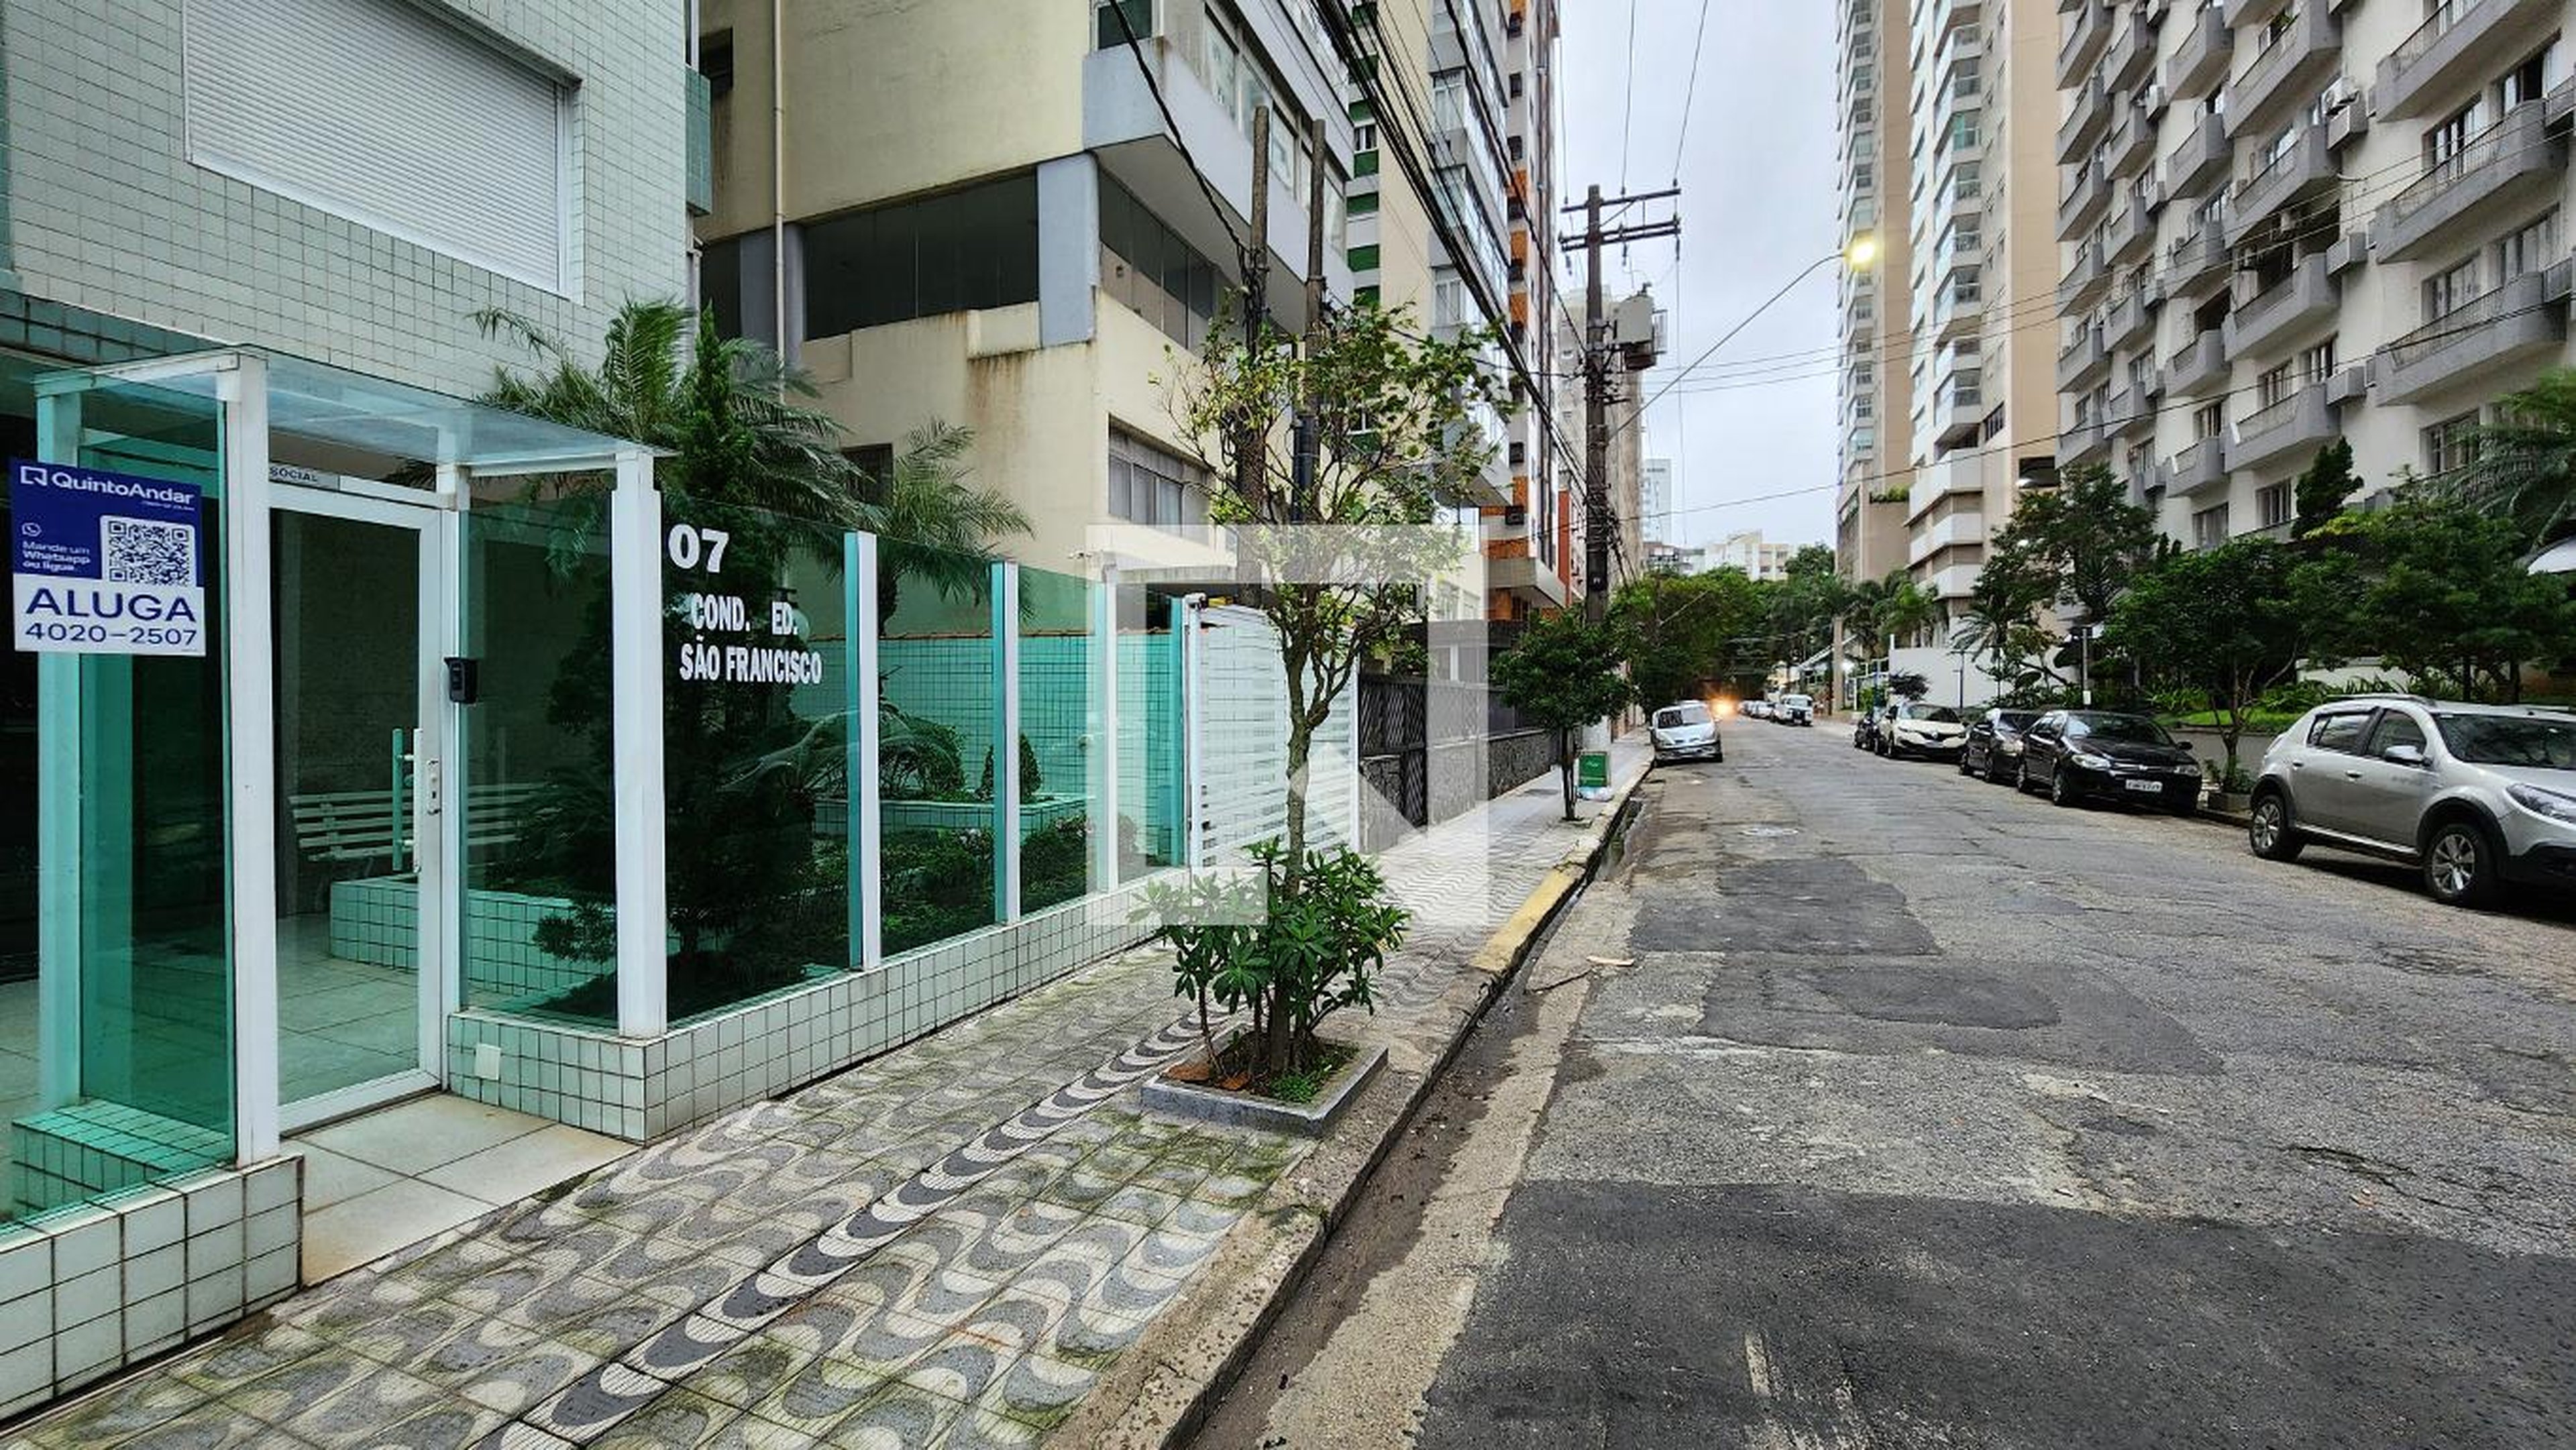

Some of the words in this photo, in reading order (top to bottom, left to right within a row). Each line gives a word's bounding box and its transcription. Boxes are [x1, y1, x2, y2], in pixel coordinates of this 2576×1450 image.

[52, 471, 195, 504] QuintoAndar
[270, 466, 318, 482] SOCIAL
[668, 524, 729, 573] 07
[25, 588, 196, 622] ALUGA
[692, 592, 751, 632] COND.
[771, 601, 798, 635] ED.
[25, 622, 197, 646] 4020-2507
[680, 634, 720, 681] SÃO
[726, 646, 822, 684] FRANCISCO
